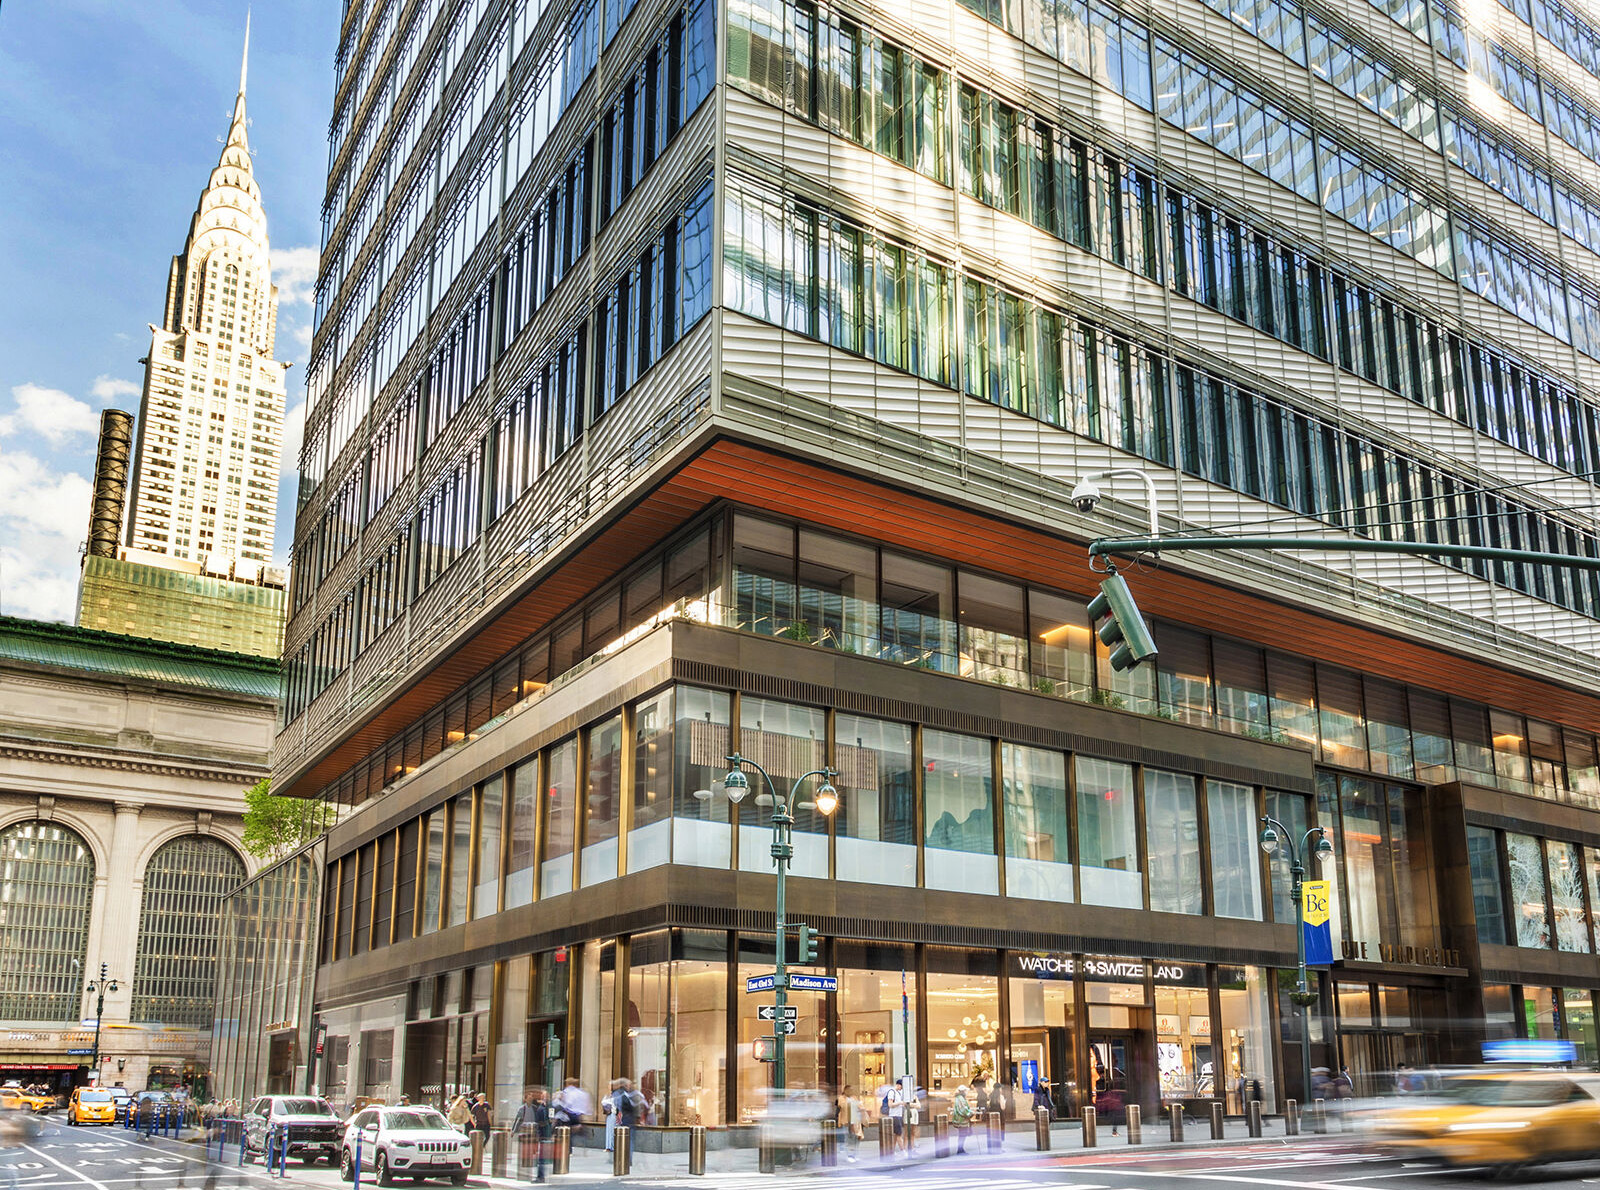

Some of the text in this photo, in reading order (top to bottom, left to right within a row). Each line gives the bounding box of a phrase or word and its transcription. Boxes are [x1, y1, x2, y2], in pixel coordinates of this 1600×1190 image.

[1306, 893, 1327, 912] Be
[1019, 956, 1085, 972] WATCHE
[791, 977, 837, 989] Madison Ave
